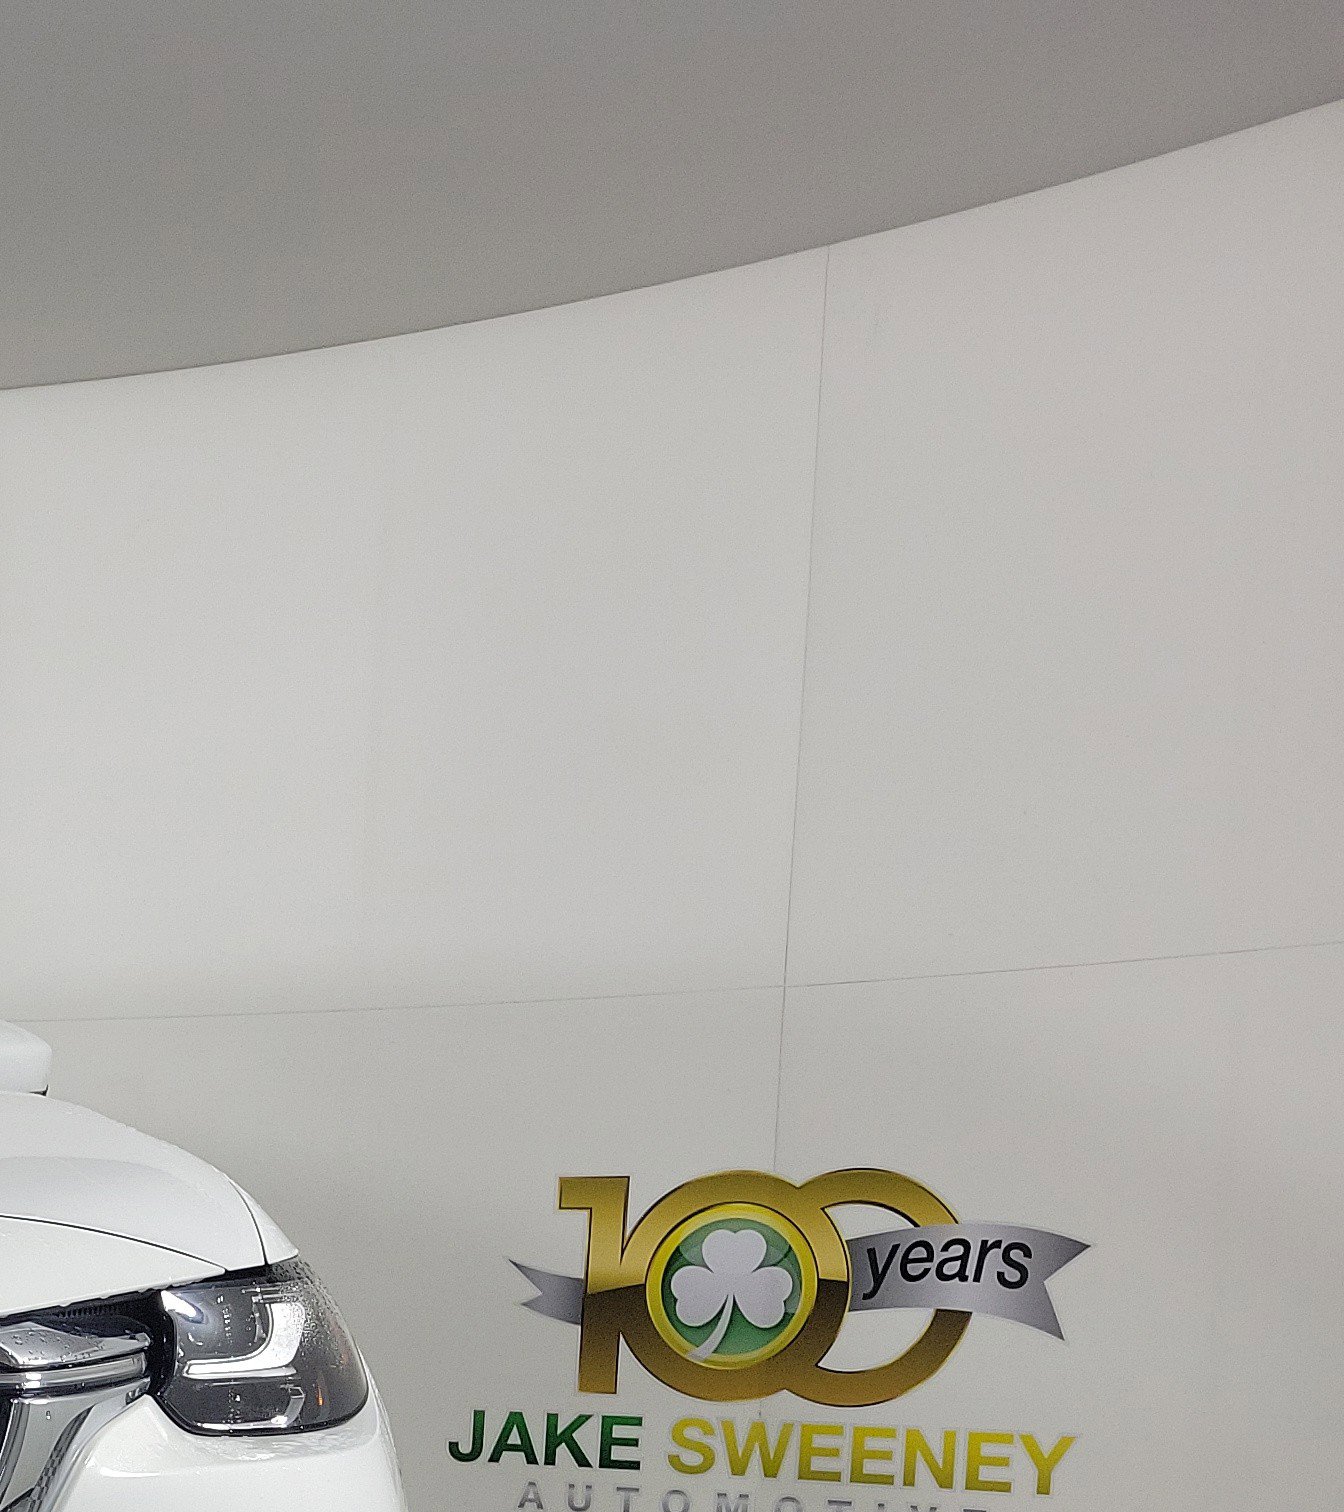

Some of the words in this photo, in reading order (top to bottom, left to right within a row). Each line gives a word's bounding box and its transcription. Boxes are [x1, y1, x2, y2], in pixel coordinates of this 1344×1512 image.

[861, 1233, 1033, 1301] years
[447, 1409, 644, 1471] JAKE
[667, 1416, 1079, 1497] SWEENEY
